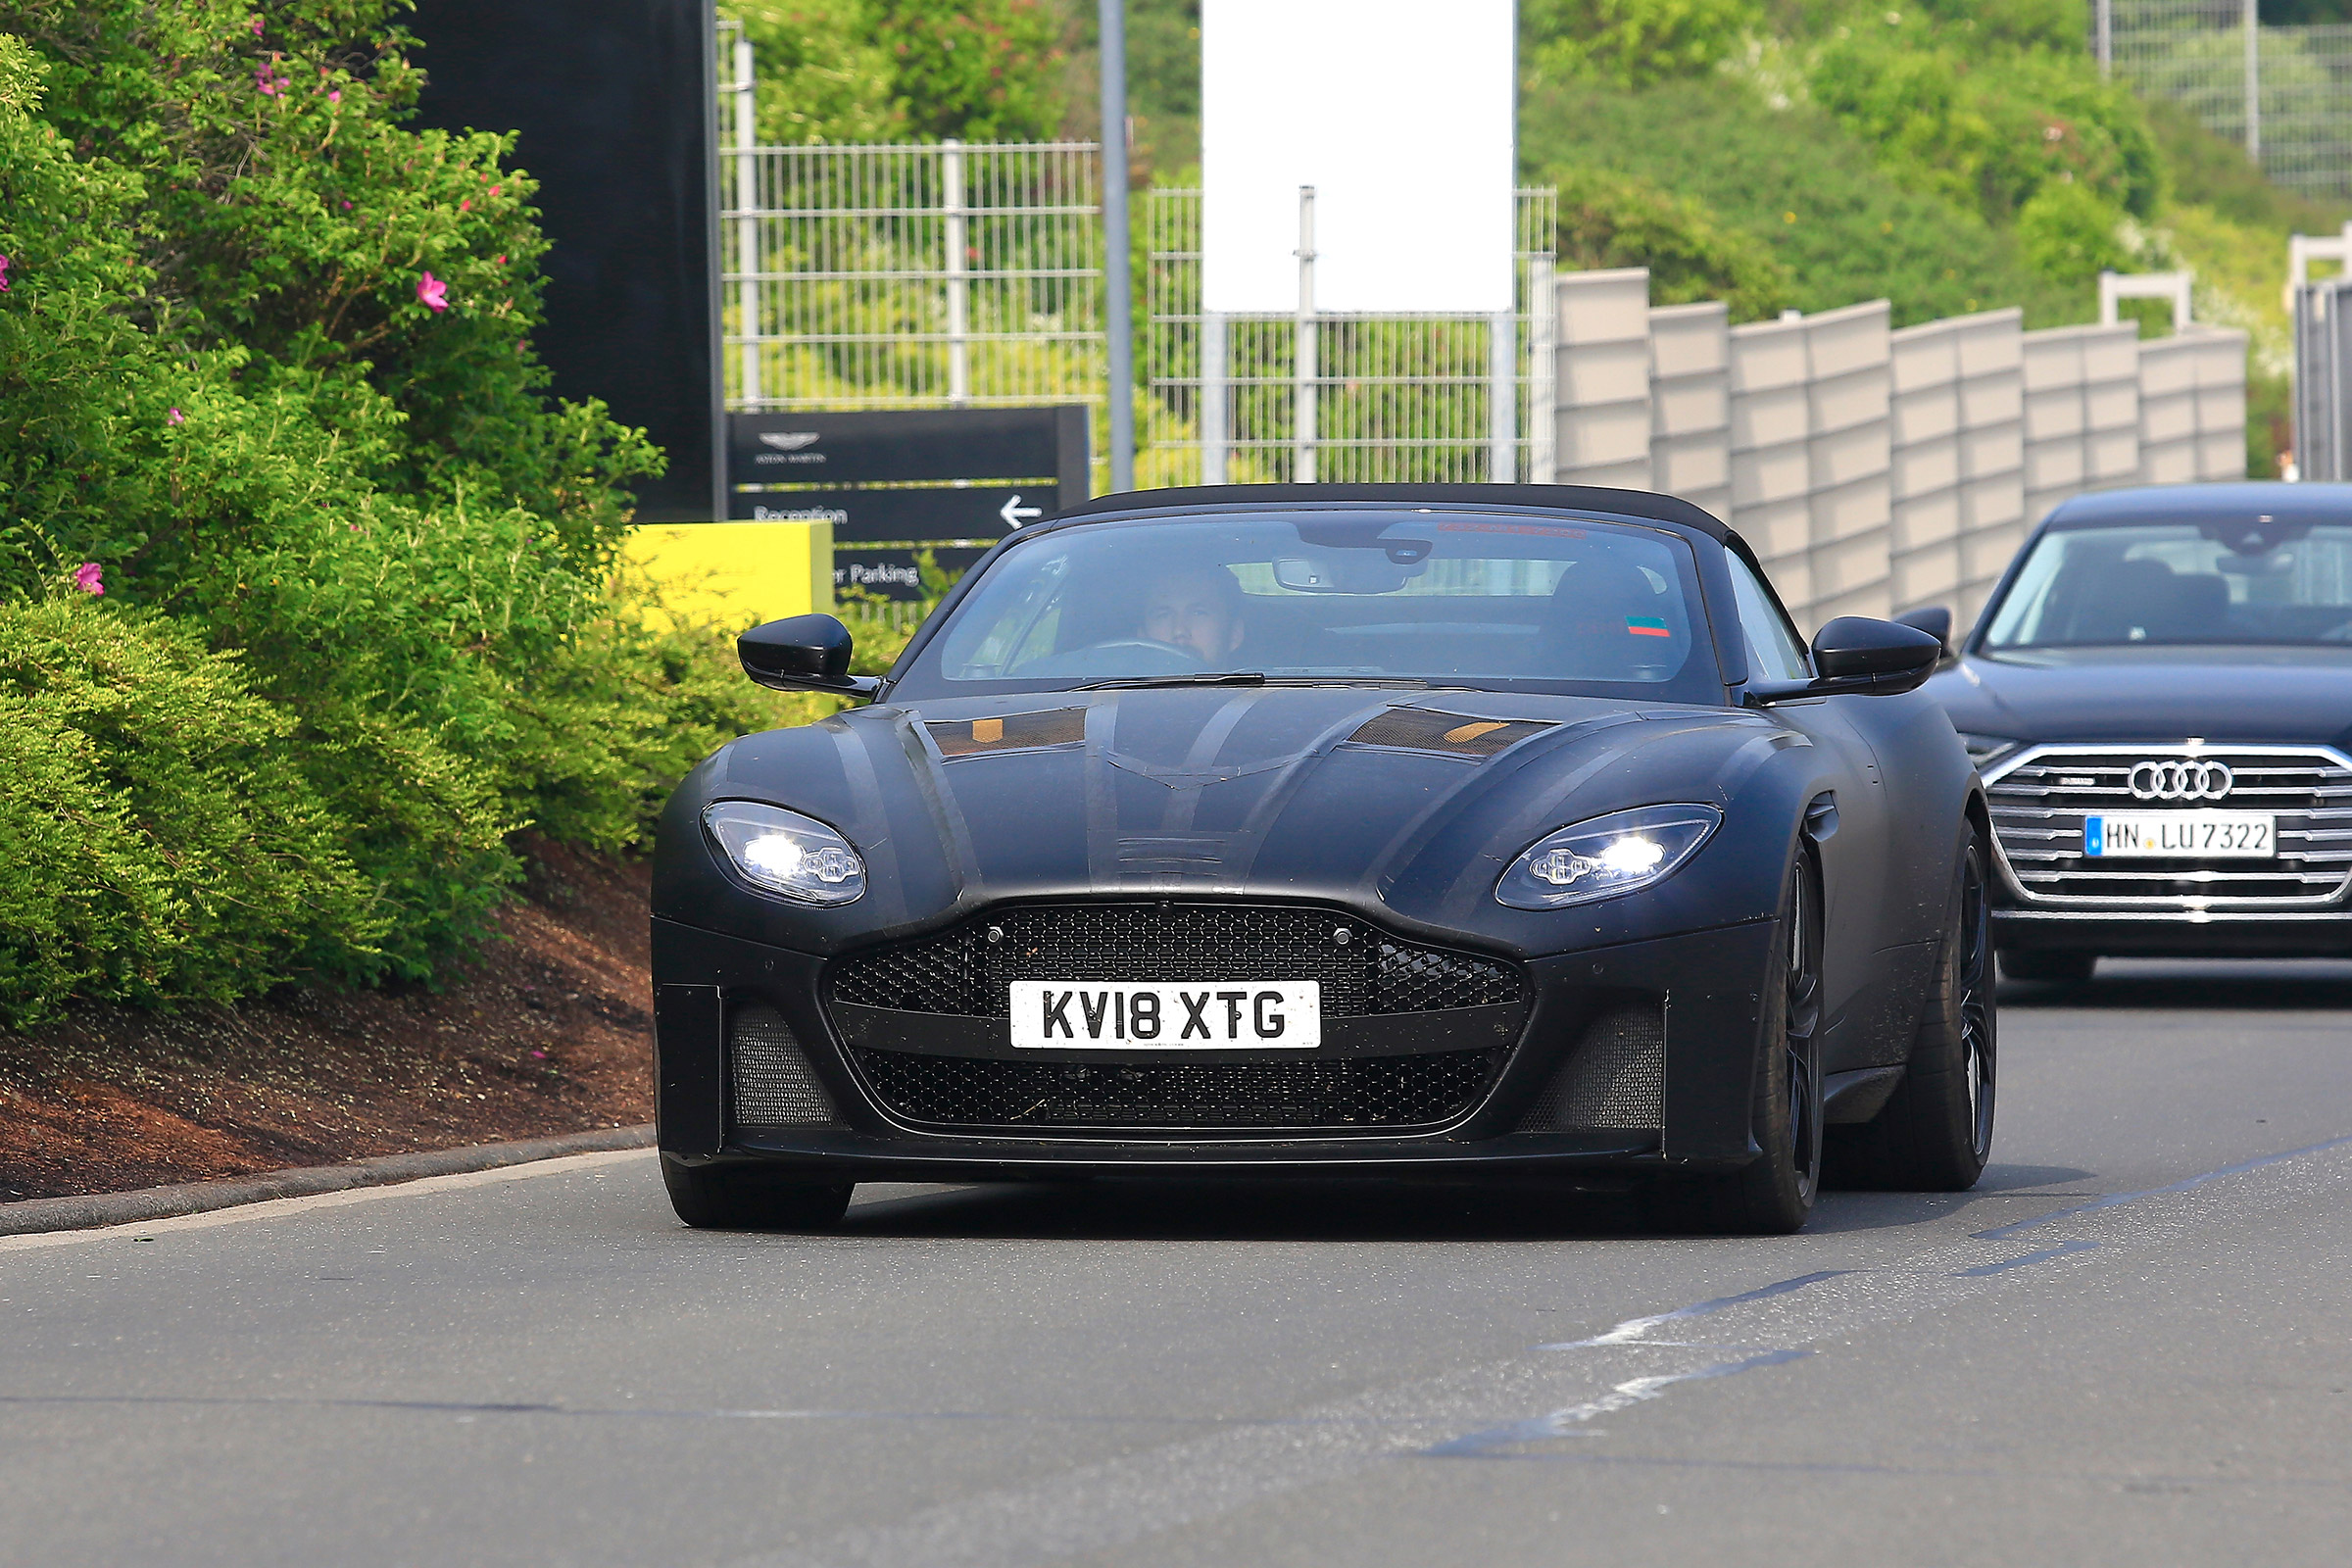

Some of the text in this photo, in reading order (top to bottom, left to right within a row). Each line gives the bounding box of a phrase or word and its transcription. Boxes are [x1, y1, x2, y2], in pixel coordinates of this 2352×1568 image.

[754, 505, 849, 525] Reception
[851, 564, 919, 587] Parking
[2106, 823, 2268, 850] HN LU 7322
[1043, 991, 1286, 1039] KV18 XTG
